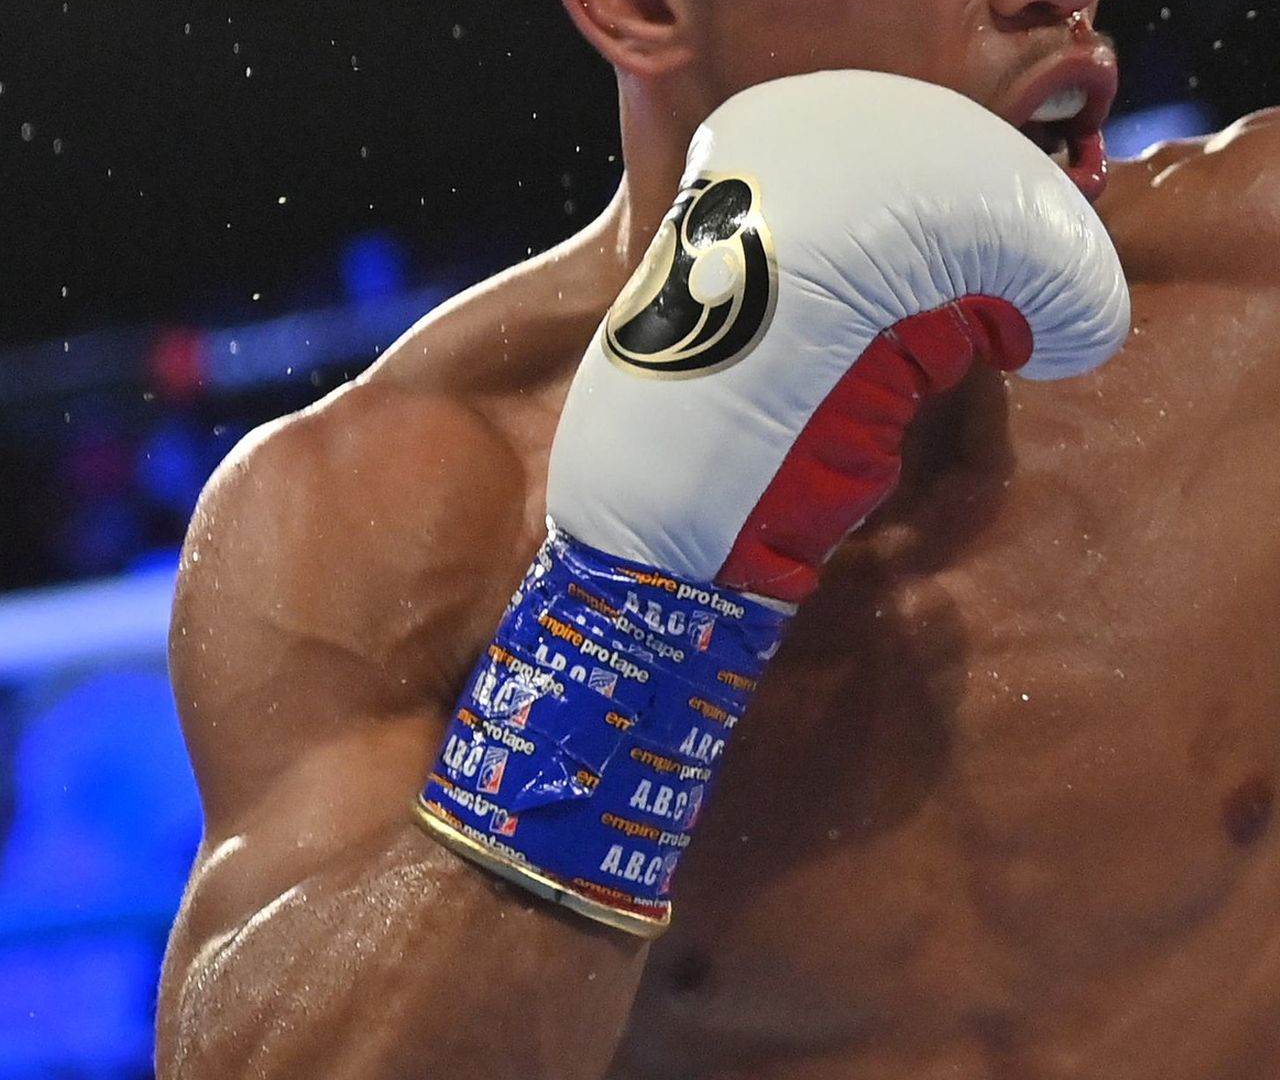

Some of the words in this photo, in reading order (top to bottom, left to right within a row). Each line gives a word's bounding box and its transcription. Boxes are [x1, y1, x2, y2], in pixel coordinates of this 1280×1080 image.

[709, 593, 746, 620] tape
[609, 649, 650, 684] tape
[629, 778, 688, 821] A.B.C
[601, 811, 660, 840] empire
[600, 844, 663, 886] A.B.C
